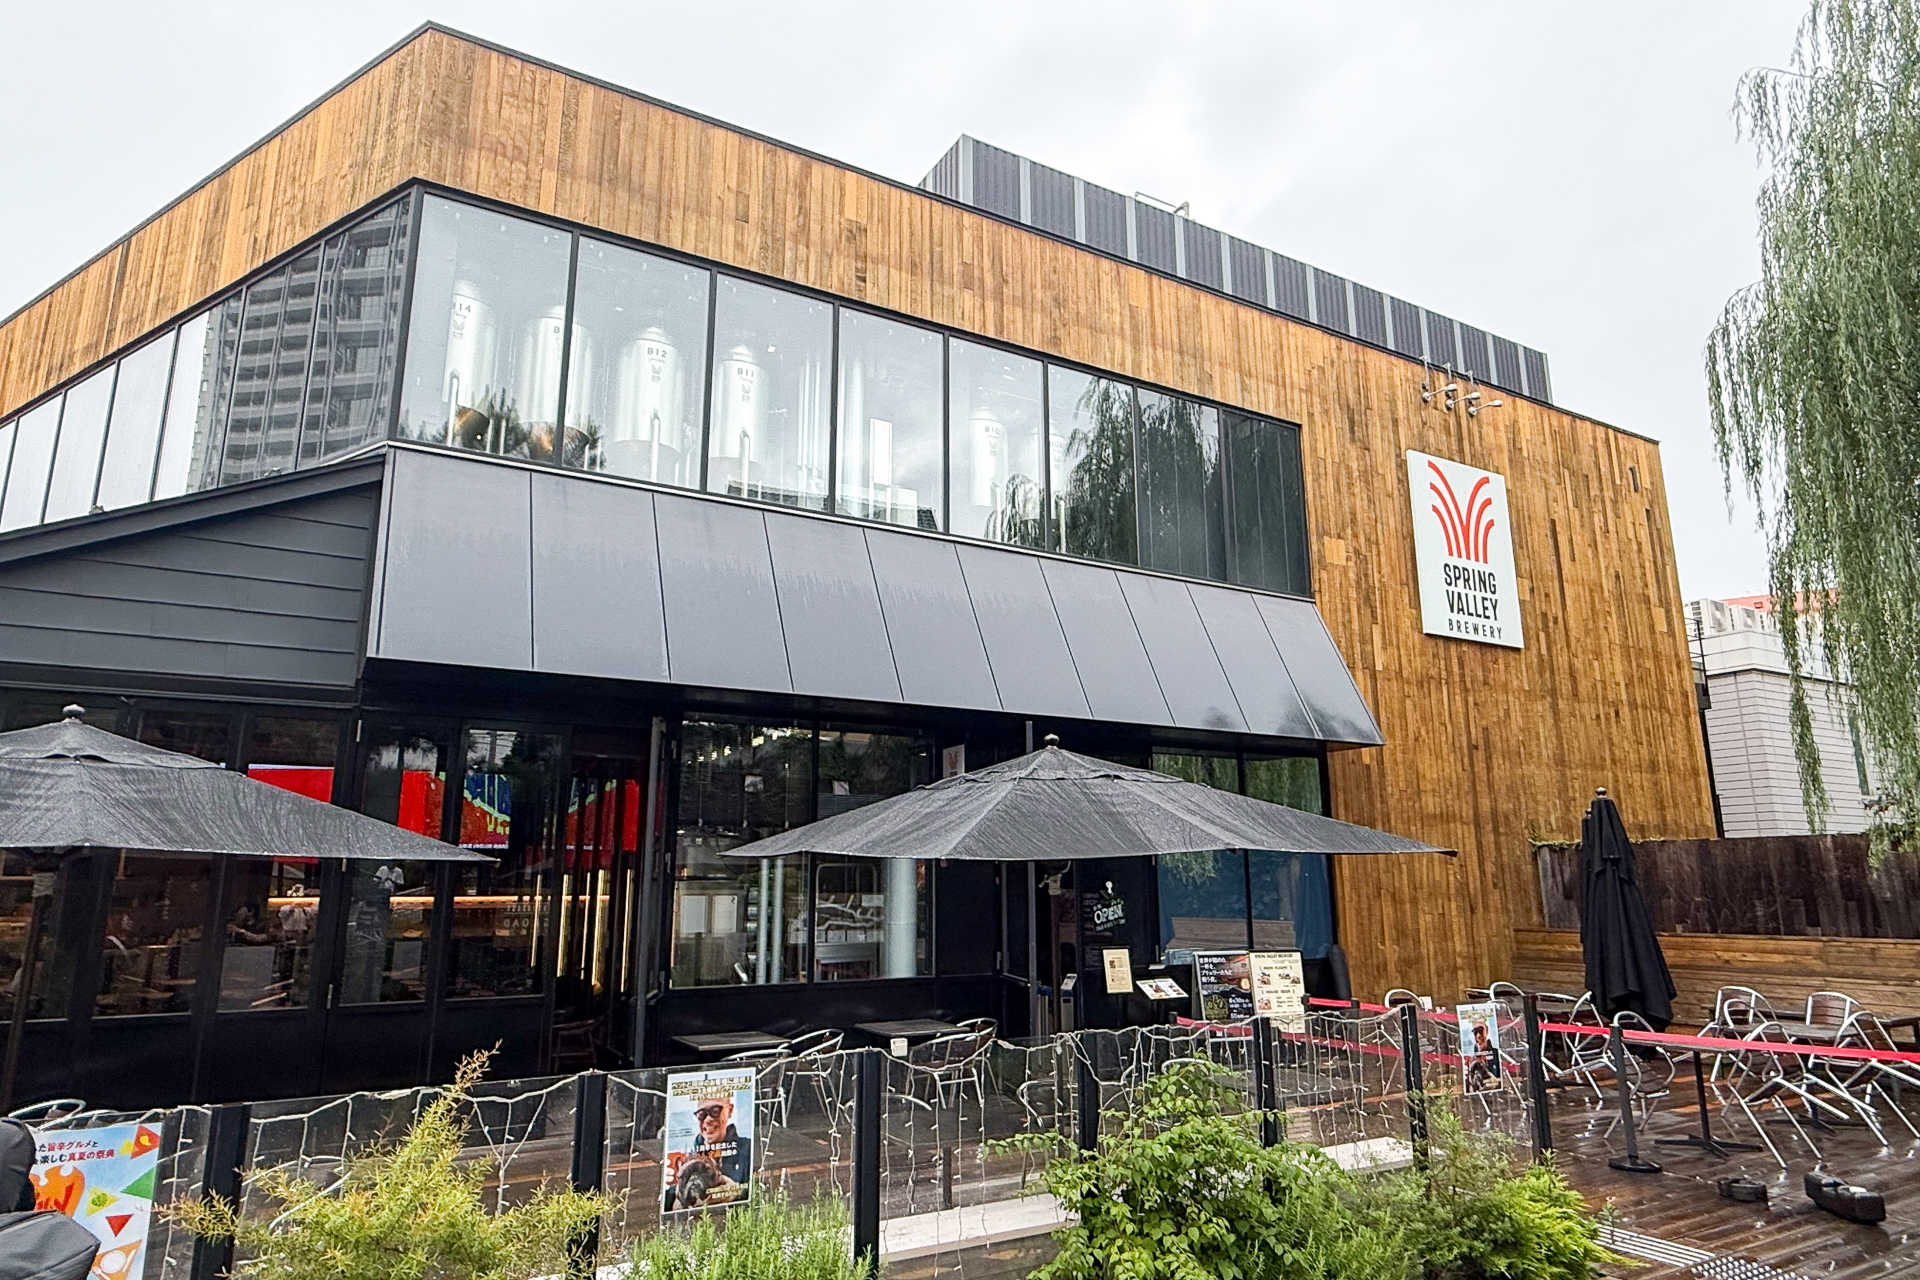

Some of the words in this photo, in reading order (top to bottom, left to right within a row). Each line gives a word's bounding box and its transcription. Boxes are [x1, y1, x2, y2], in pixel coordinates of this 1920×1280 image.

[1443, 563, 1497, 595] SPRING
[1446, 589, 1498, 621] VALLEY
[1448, 618, 1502, 640] BREWERY
[1094, 903, 1124, 924] OPEN
